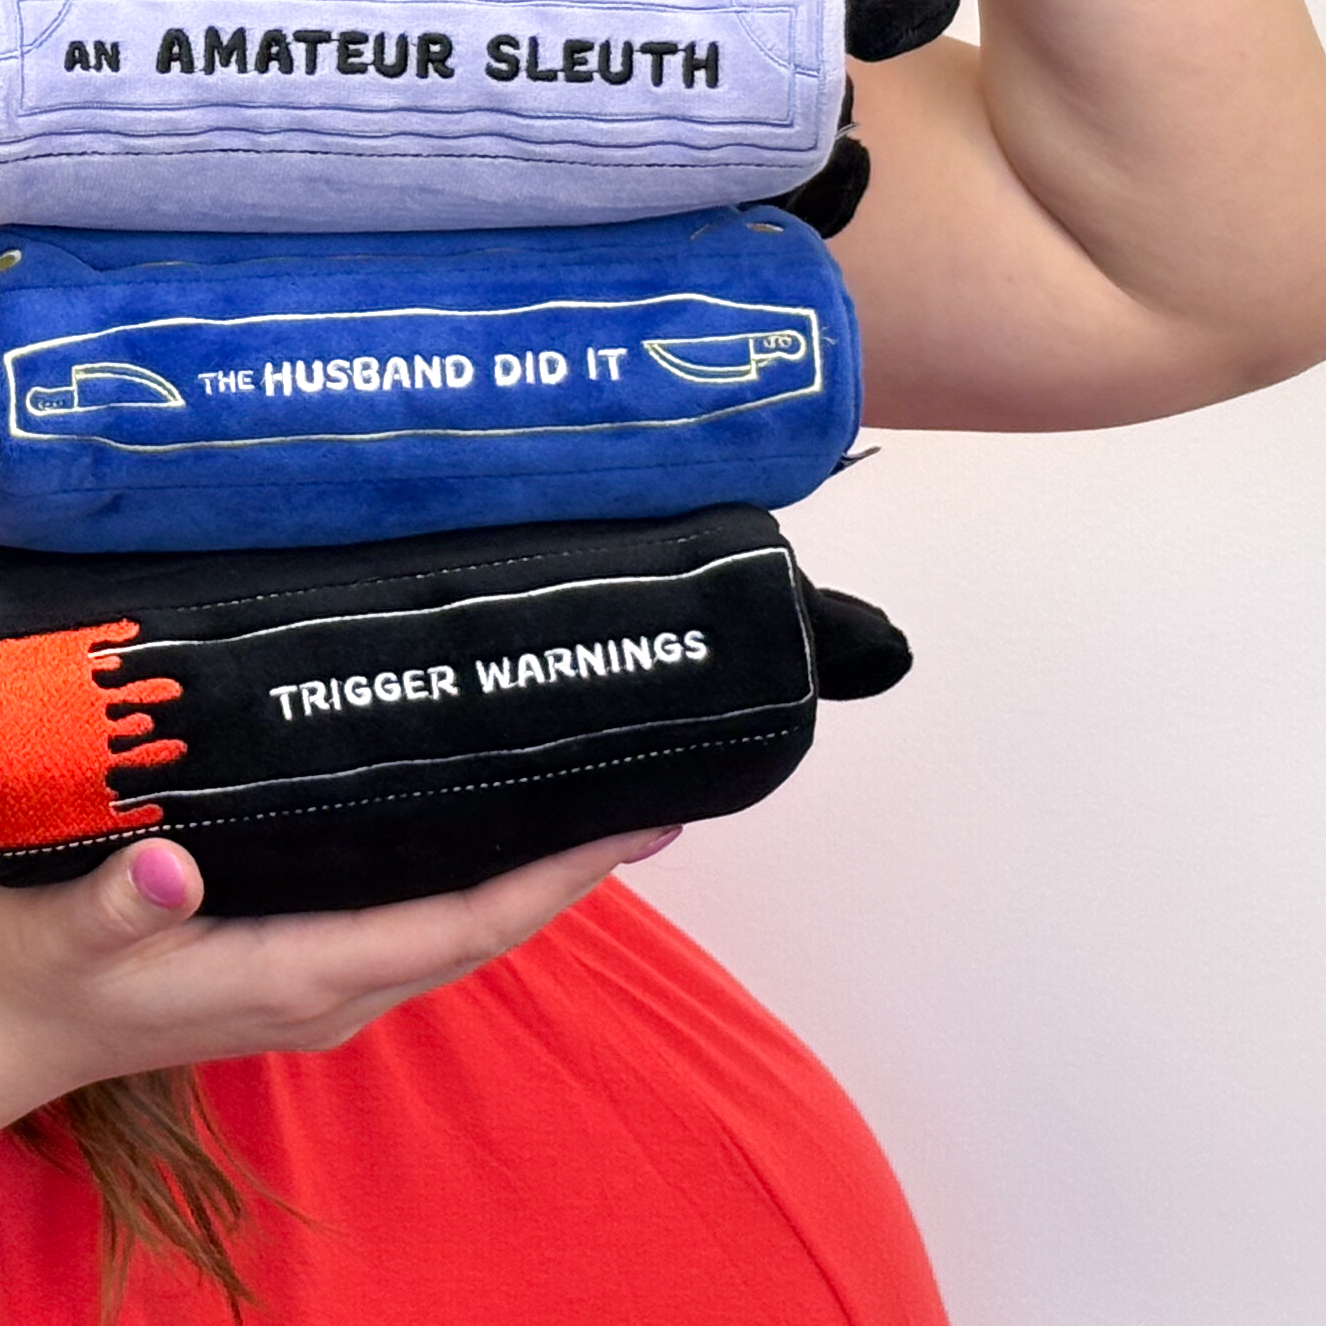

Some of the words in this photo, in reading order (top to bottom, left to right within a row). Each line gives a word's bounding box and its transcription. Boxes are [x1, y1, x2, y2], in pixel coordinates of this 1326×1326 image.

[63, 39, 122, 74] AN
[154, 25, 455, 80] AMATEUR
[484, 33, 721, 90] SLEUTH
[197, 368, 257, 396] THE
[261, 353, 476, 399] HUSBAND
[492, 349, 570, 389] DID
[585, 345, 628, 383] IT
[267, 664, 460, 722] TRIGGER
[474, 628, 710, 695] WARNINGS
